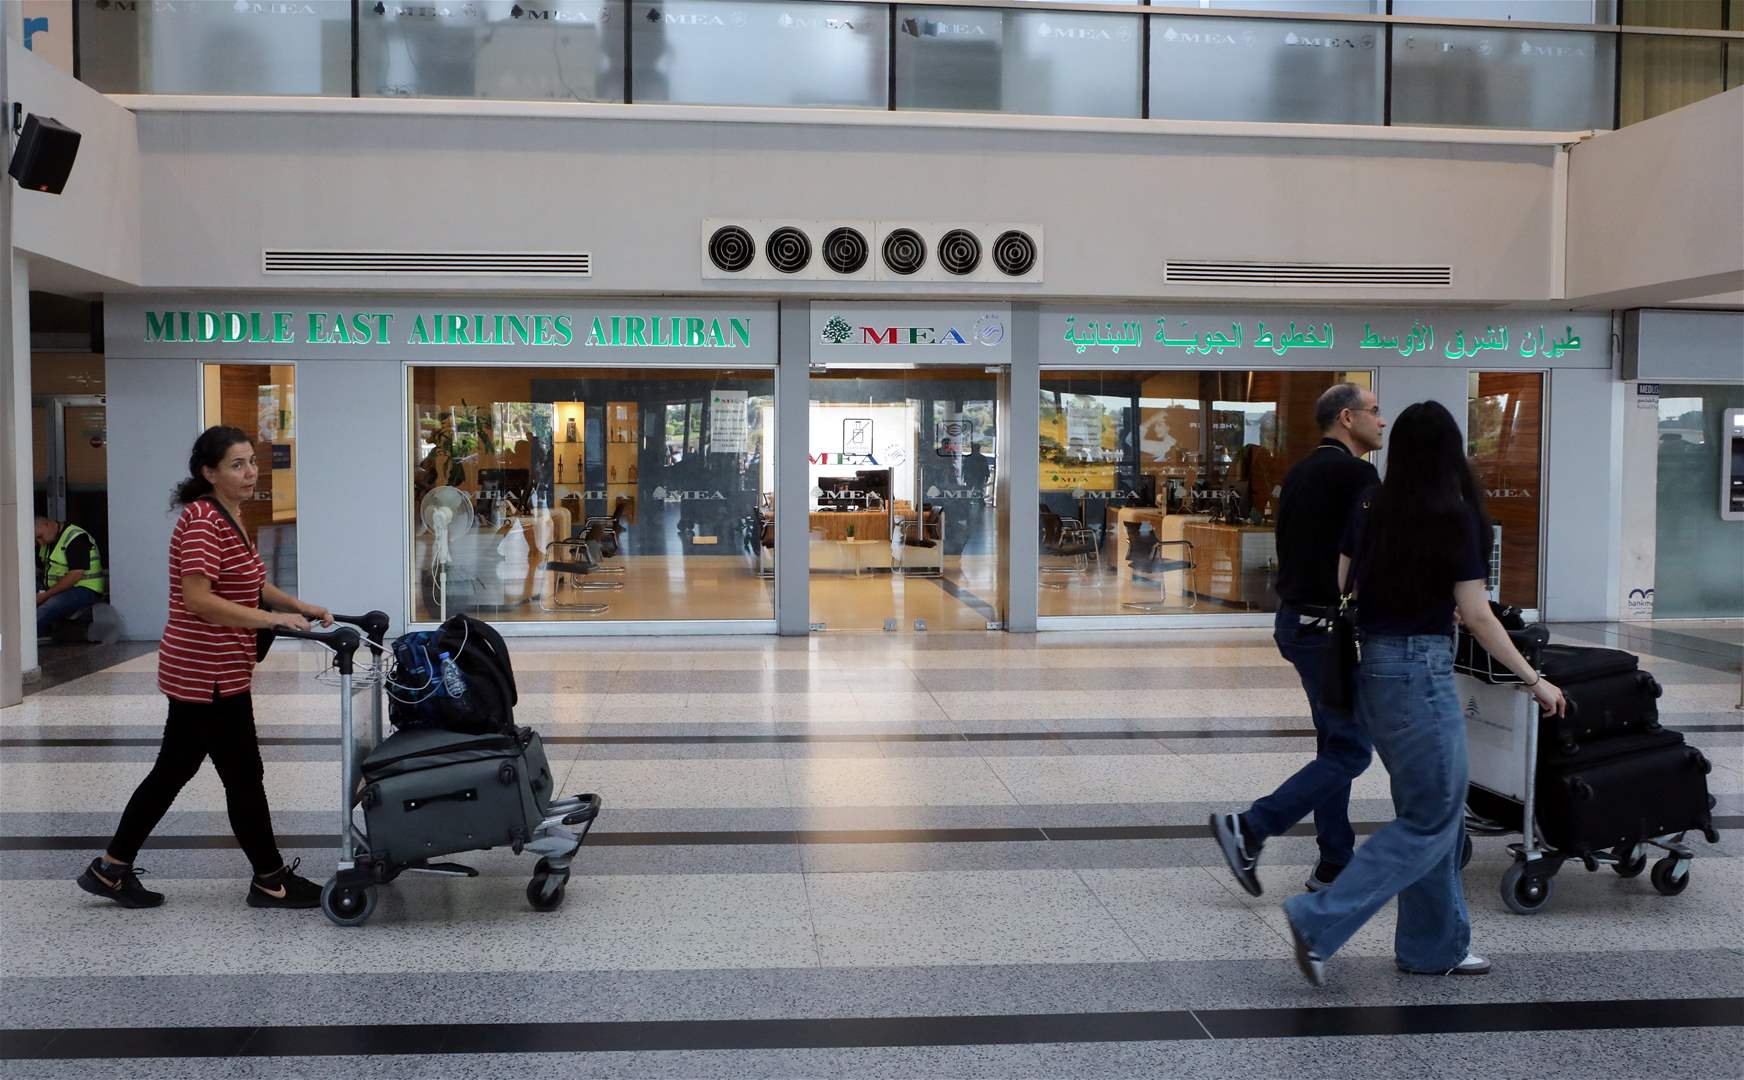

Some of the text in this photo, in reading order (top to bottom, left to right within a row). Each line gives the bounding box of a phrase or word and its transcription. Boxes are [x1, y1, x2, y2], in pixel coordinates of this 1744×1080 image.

[665, 14, 726, 25] MEA
[1054, 27, 1112, 40] MEA
[1182, 32, 1236, 44] MEA
[1301, 38, 1355, 48] MEA
[1535, 47, 1585, 57] MEA
[145, 311, 751, 347] MIDDLE EAST AIRLINES AIRLIBAN
[1064, 315, 1142, 354] اللبنانية
[859, 326, 971, 346] MEA
[1254, 320, 1334, 356] الخطوط
[1359, 319, 1434, 357] الأوسط
[1443, 324, 1508, 359] الشرق
[1519, 325, 1582, 358] طيران
[671, 489, 728, 500] MEA
[825, 490, 880, 500] MEA
[1088, 489, 1141, 499] MEA
[1190, 489, 1241, 499] MEA
[1483, 488, 1533, 498] MEA
